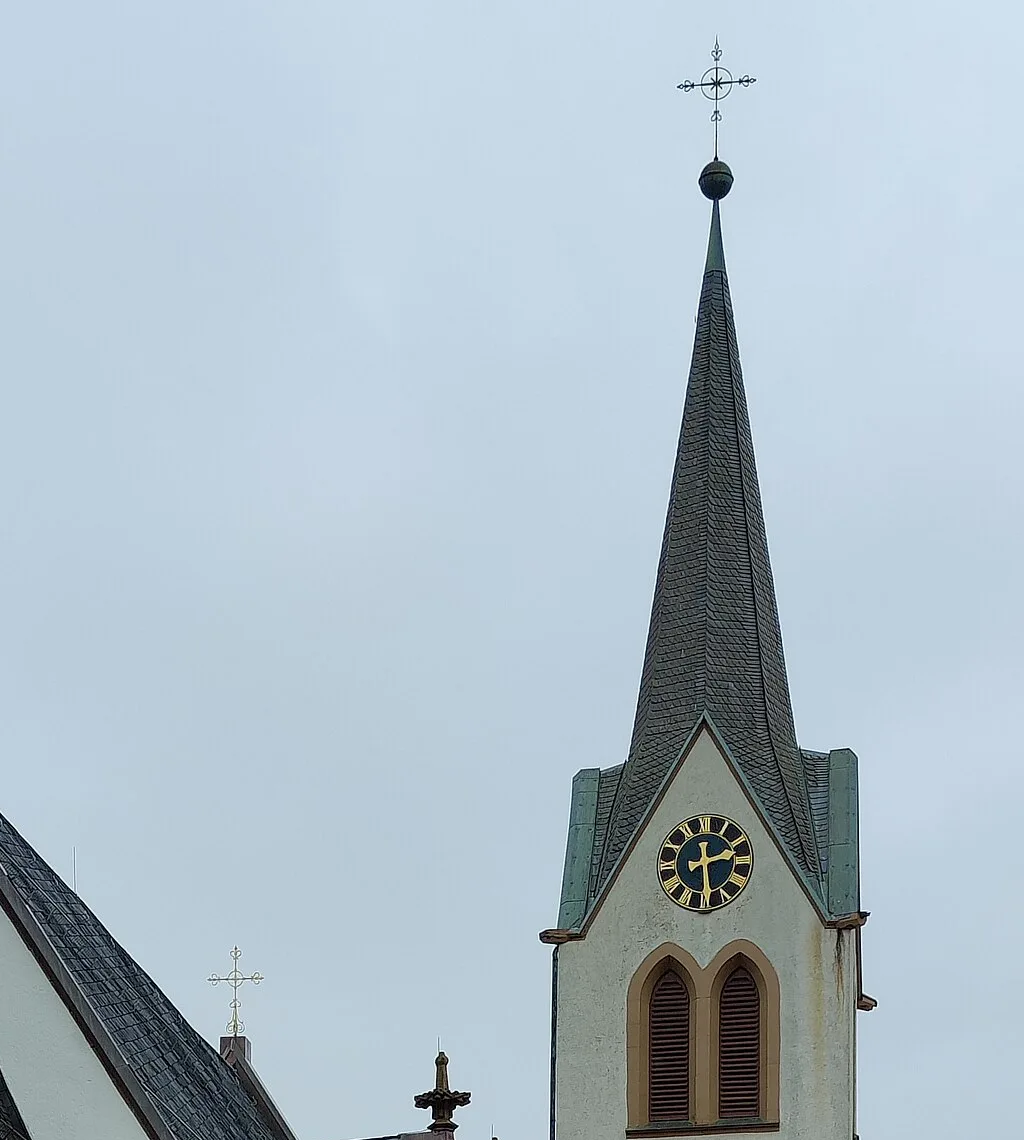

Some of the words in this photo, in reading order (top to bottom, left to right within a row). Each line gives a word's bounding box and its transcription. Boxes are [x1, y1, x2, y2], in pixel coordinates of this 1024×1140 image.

[678, 823, 694, 839] XI
[699, 818, 710, 832] XII
[719, 821, 728, 835] I
[664, 840, 680, 853] X
[731, 834, 746, 847] II
[661, 860, 674, 871] IX
[736, 856, 751, 864] III
[664, 876, 680, 893] VIII
[679, 889, 692, 905] VII
[720, 889, 731, 902] V
